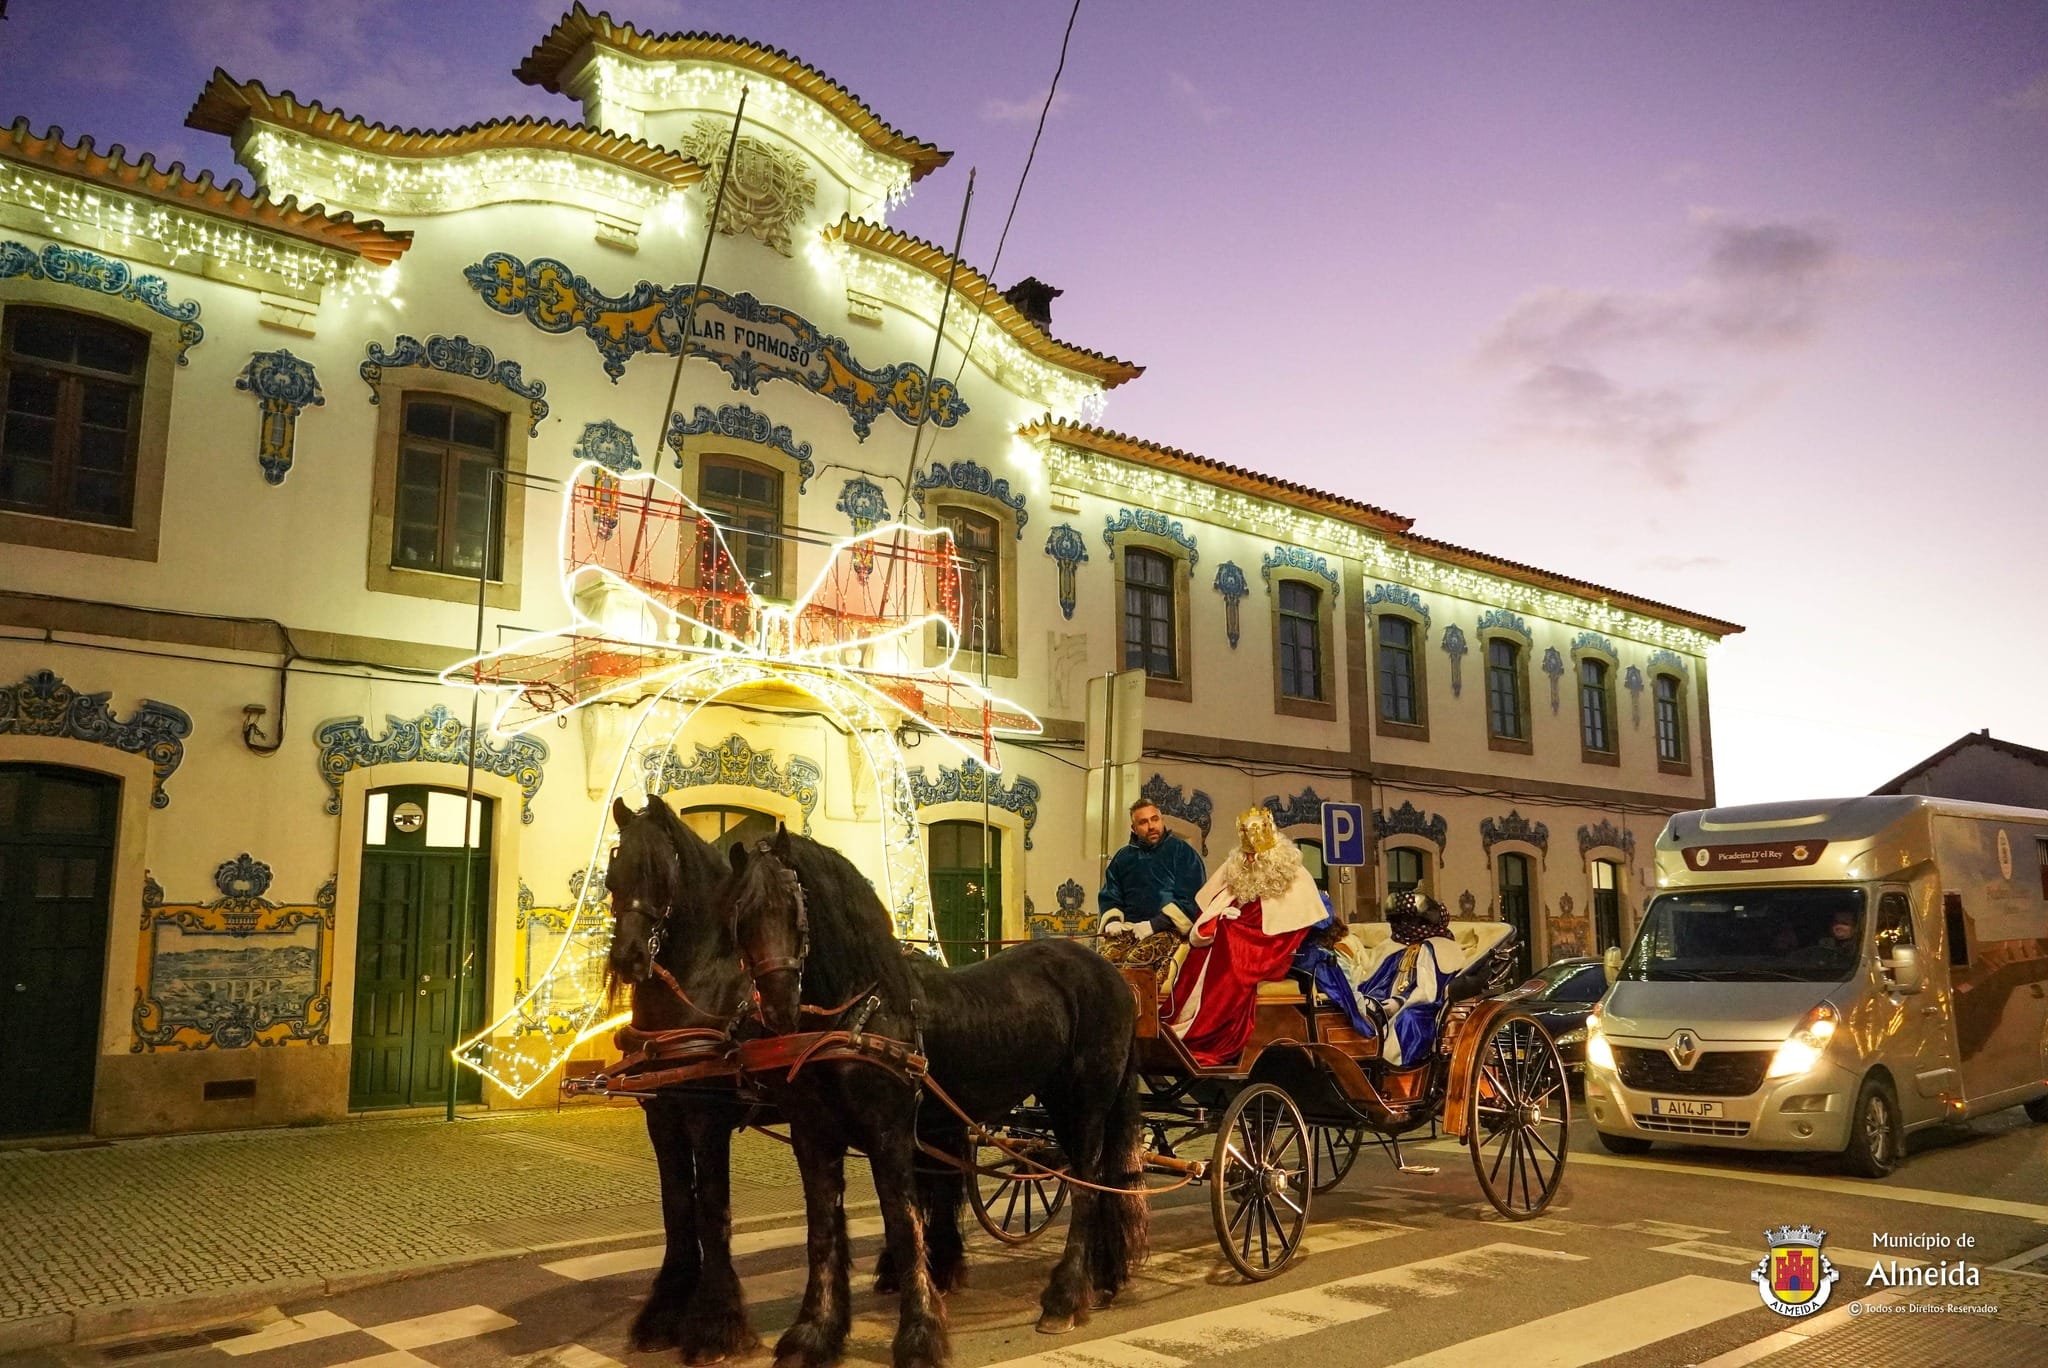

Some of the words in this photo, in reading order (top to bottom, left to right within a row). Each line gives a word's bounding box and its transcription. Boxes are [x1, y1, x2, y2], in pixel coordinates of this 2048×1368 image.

[676, 316, 726, 340] VLAR
[734, 326, 810, 367] FORMOSO
[1332, 809, 1355, 859] P
[1718, 851, 1751, 861] Picadeiro
[1768, 850, 1783, 860] Rey
